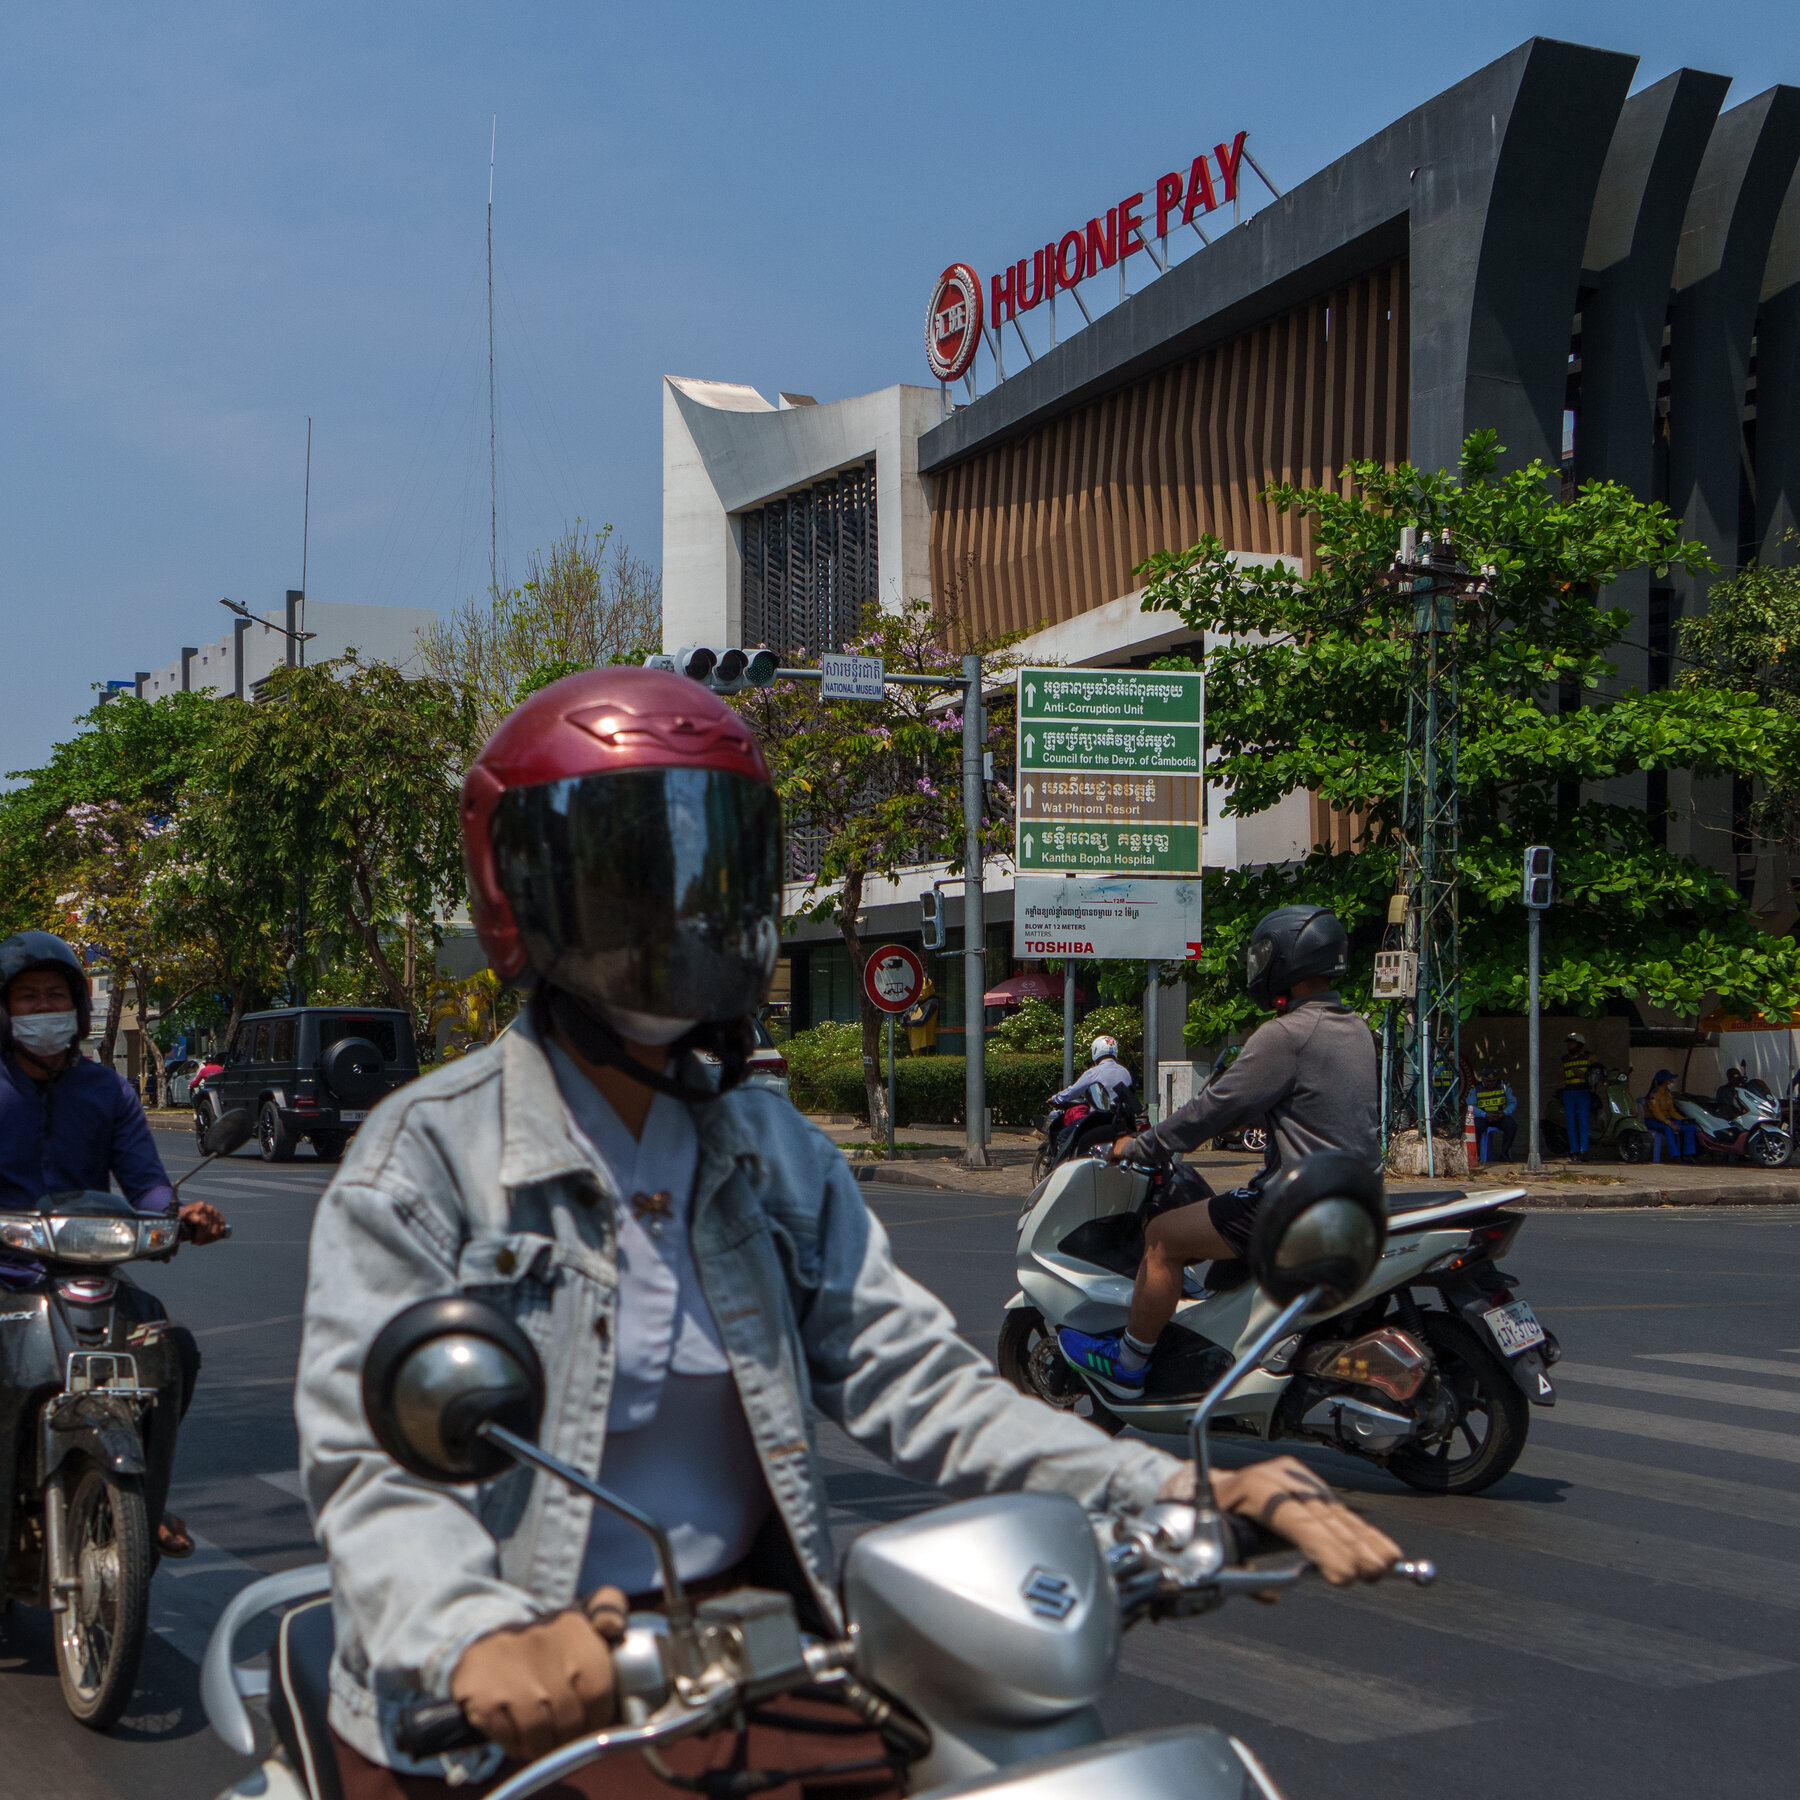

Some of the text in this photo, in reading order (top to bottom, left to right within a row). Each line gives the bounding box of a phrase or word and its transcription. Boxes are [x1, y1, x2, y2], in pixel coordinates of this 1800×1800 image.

[991, 130, 1247, 329] HUIONE PAY
[825, 682, 881, 695] NATIONAL MUSEUM
[1043, 702, 1144, 715] Anti-Corruption Unit
[1042, 753, 1197, 767] Council for the Devp. of Cambodia
[1041, 802, 1141, 815] Wat Phnom Resort
[1041, 852, 1155, 866] Kantha Bopha Hospital
[1115, 909, 1123, 917] 12
[1025, 941, 1094, 953] TOSHIBA
